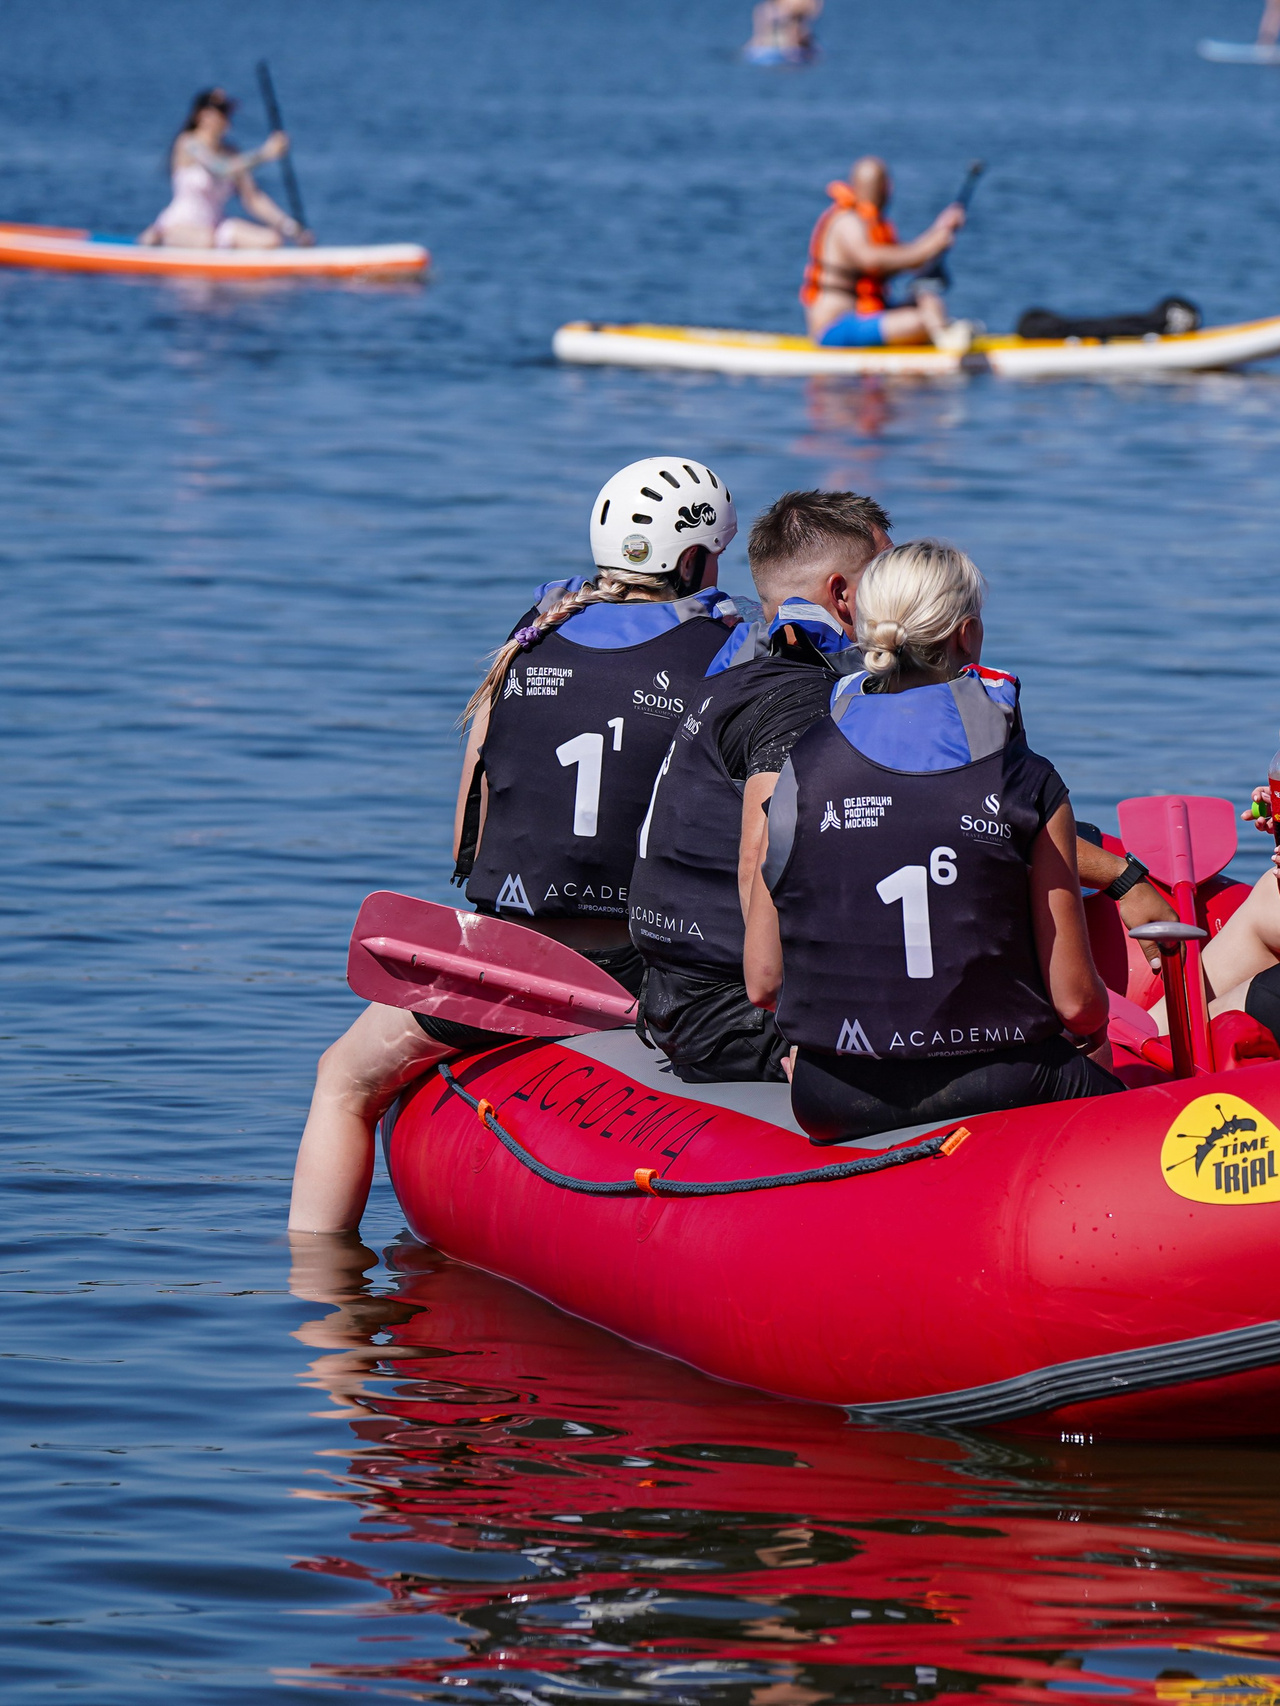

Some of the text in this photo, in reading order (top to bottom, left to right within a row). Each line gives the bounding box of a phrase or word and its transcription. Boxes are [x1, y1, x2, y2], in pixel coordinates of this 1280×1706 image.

[526, 667, 573, 678] ФЕДЕРАЦИЯ
[526, 677, 565, 687] РАФТИНГА
[525, 686, 558, 696] МОСКВЫ
[555, 717, 624, 837] 1 1
[843, 796, 893, 808] ФЕДЕРАЦИЯ
[844, 807, 885, 819] РАФТИНГА
[844, 817, 879, 829] МОСКВЫ
[543, 882, 628, 901] ACADE
[876, 846, 958, 979] 1 6
[631, 905, 705, 941] ACADEMIA
[889, 1026, 1026, 1051] ACADEMIA
[497, 1057, 719, 1178] ACADEMIA
